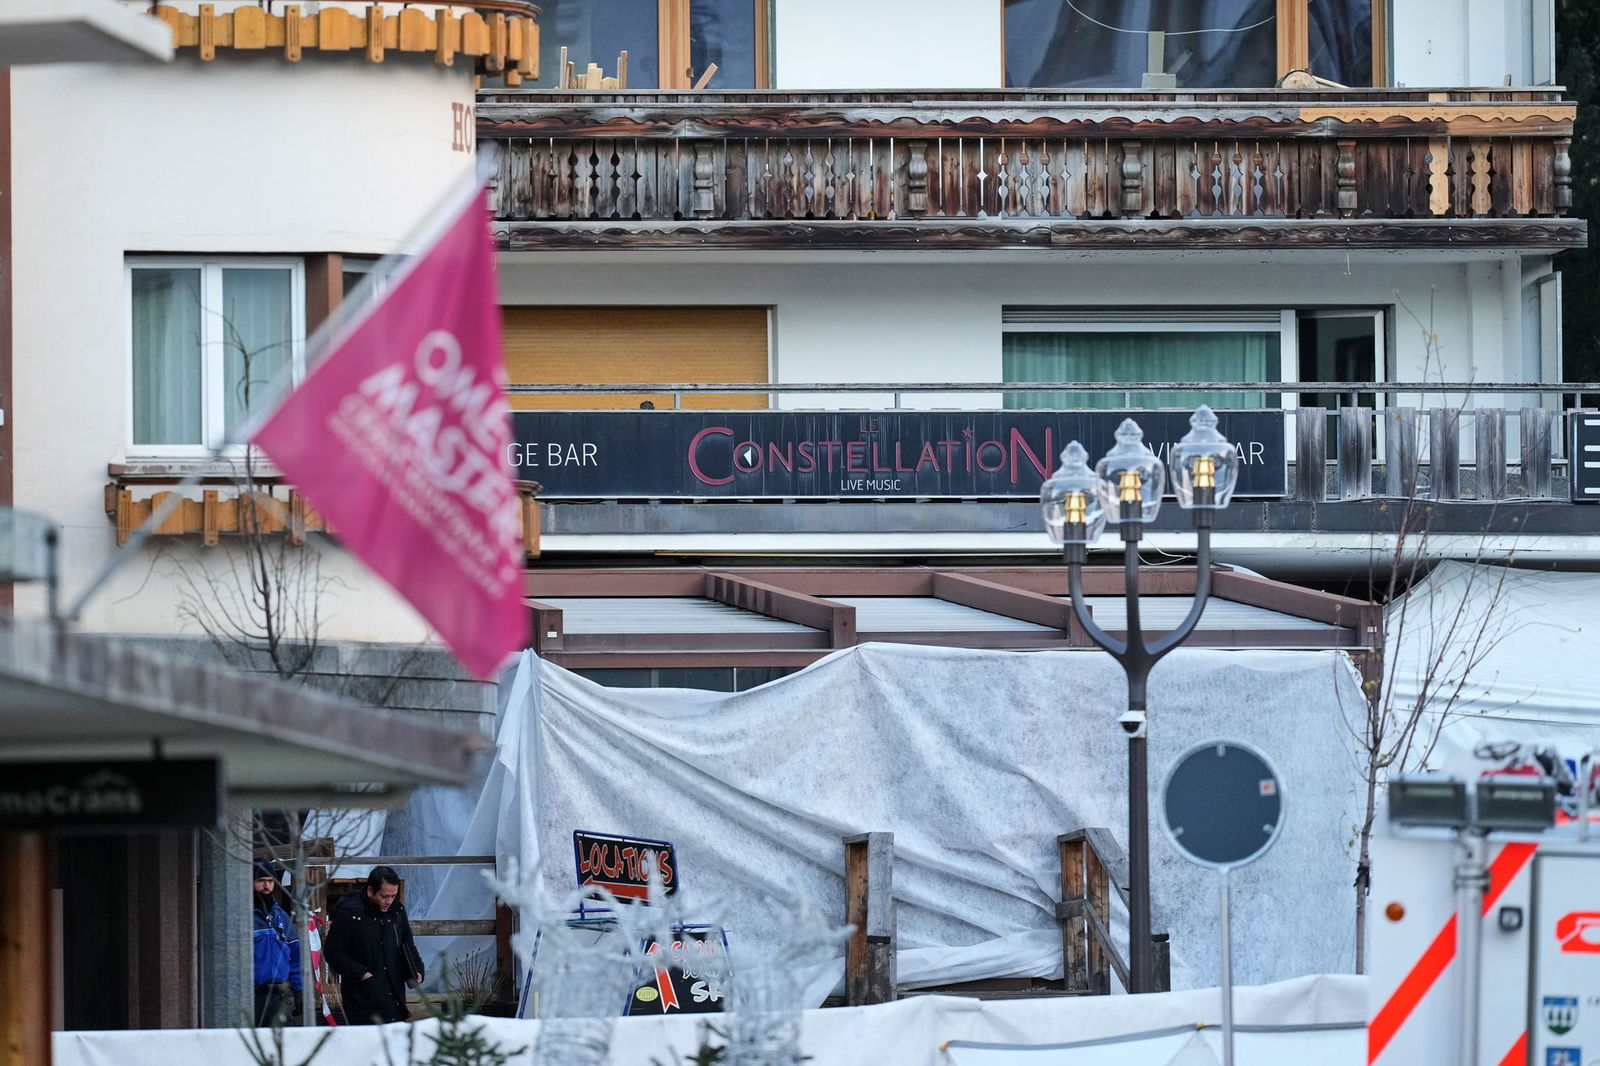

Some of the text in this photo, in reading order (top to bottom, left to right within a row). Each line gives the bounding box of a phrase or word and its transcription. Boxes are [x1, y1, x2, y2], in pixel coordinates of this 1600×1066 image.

[451, 101, 476, 155] HO
[860, 414, 880, 433] LE
[547, 443, 598, 467] BAR
[688, 425, 1053, 486] CONSTELLATION
[1234, 441, 1265, 465] AR
[841, 479, 902, 491] LIVE MUSIC
